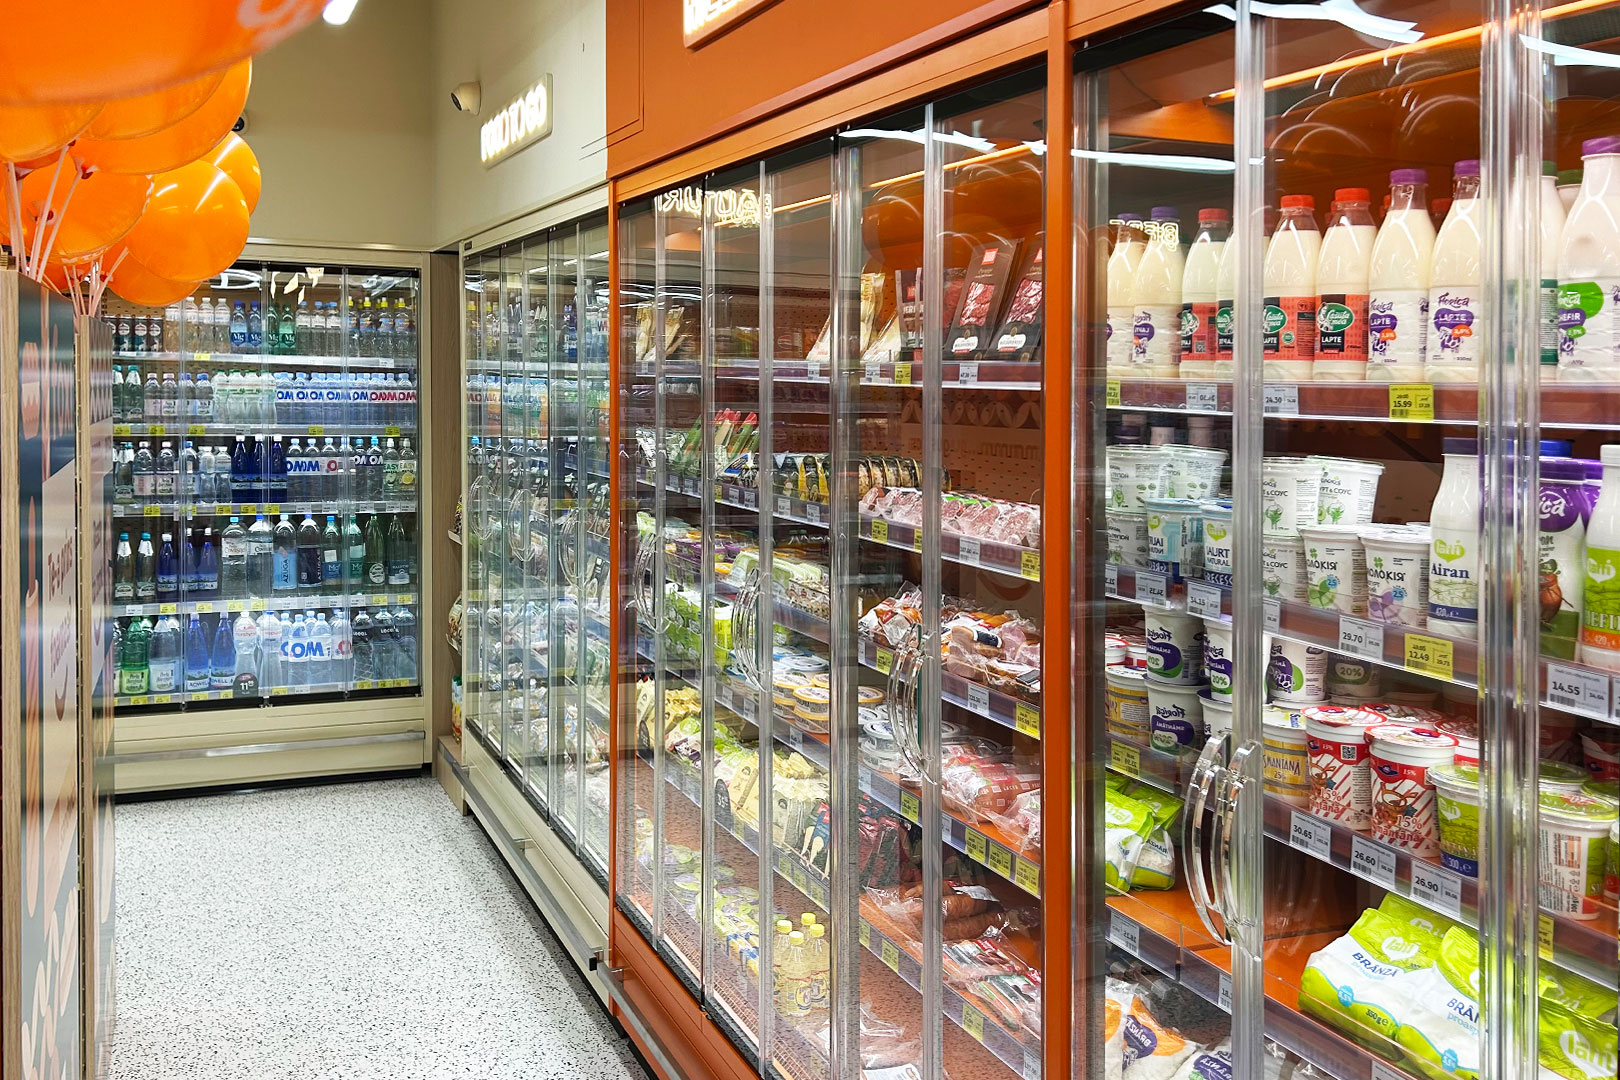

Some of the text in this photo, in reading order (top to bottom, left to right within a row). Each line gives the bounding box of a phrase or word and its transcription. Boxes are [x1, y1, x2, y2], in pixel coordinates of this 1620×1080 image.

[1431, 562, 1470, 579] Airan
[1342, 631, 1364, 644] 29.70
[1409, 650, 1430, 661] 12.49
[1340, 666, 1361, 677] 20%
[1552, 680, 1581, 696] 14.55
[1293, 824, 1313, 840] 30.65
[1354, 850, 1376, 866] 26.60
[1415, 876, 1439, 892] 26.90
